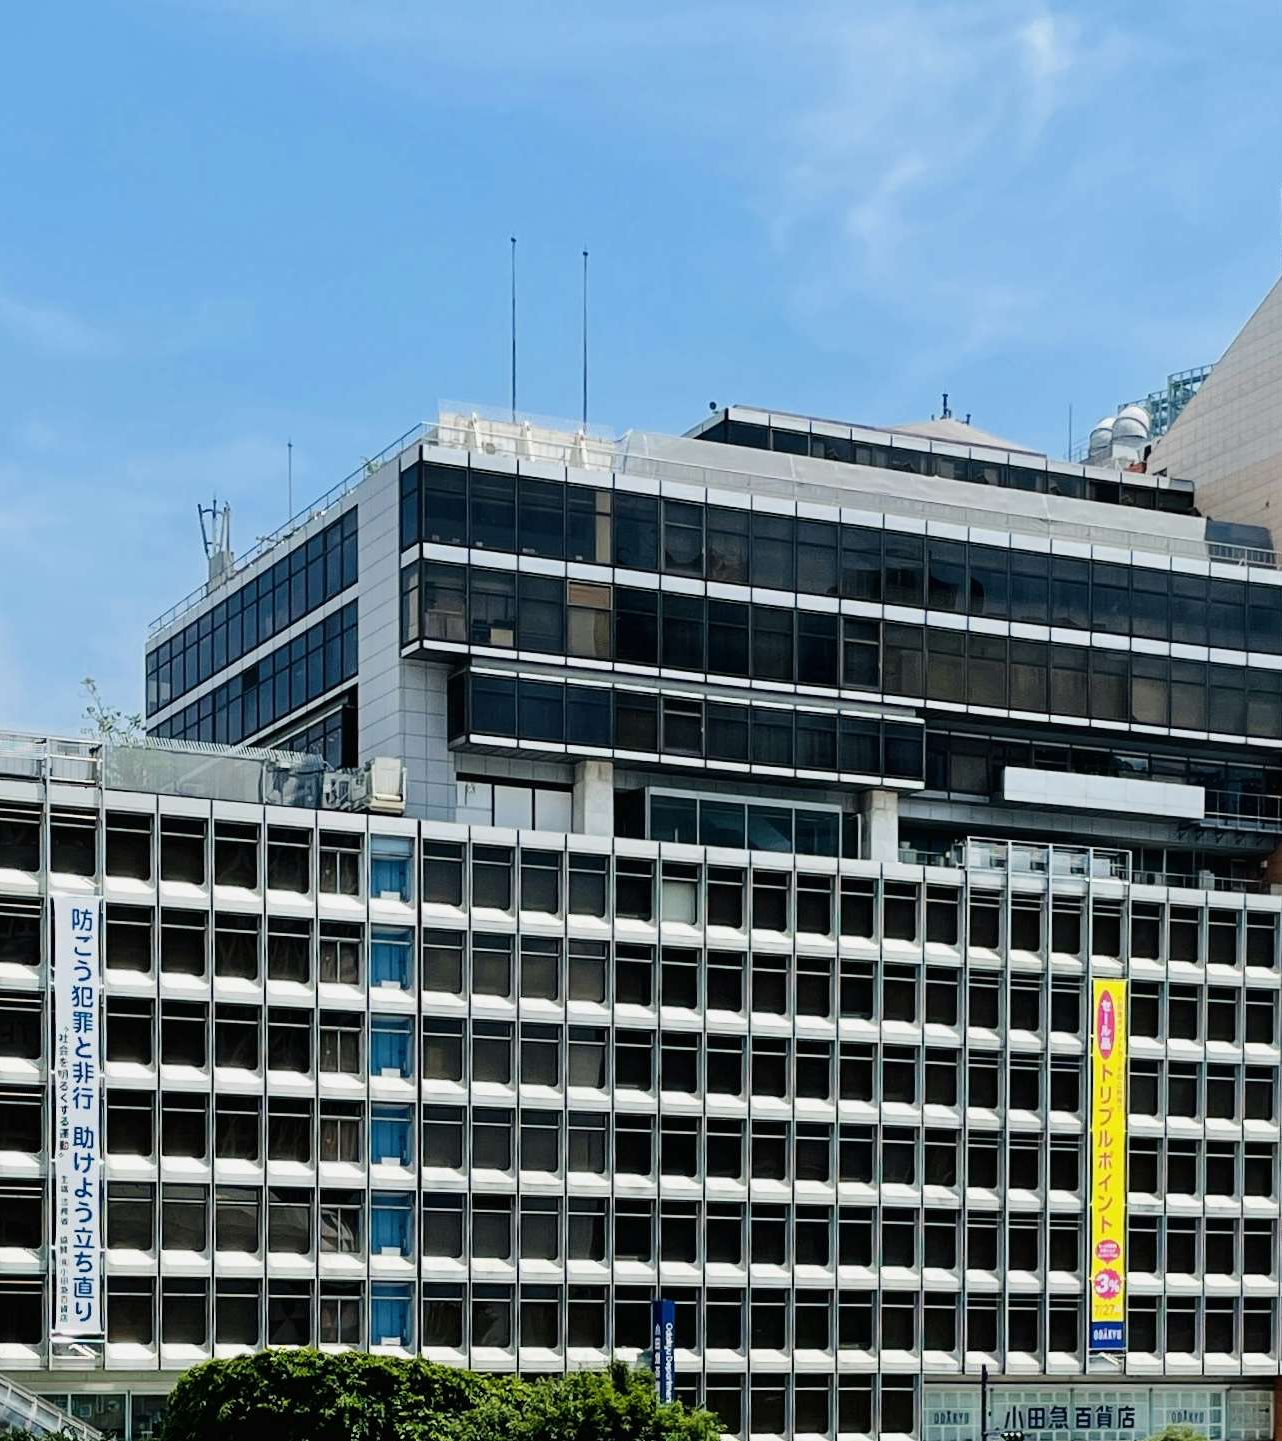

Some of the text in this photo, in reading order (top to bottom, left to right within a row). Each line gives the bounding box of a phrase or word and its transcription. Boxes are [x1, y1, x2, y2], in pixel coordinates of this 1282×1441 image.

[71, 908, 95, 1324] 防ごう犯罪と非行 助けよう立ち直り
[1004, 1405, 1136, 1430] 小田急百貨店
